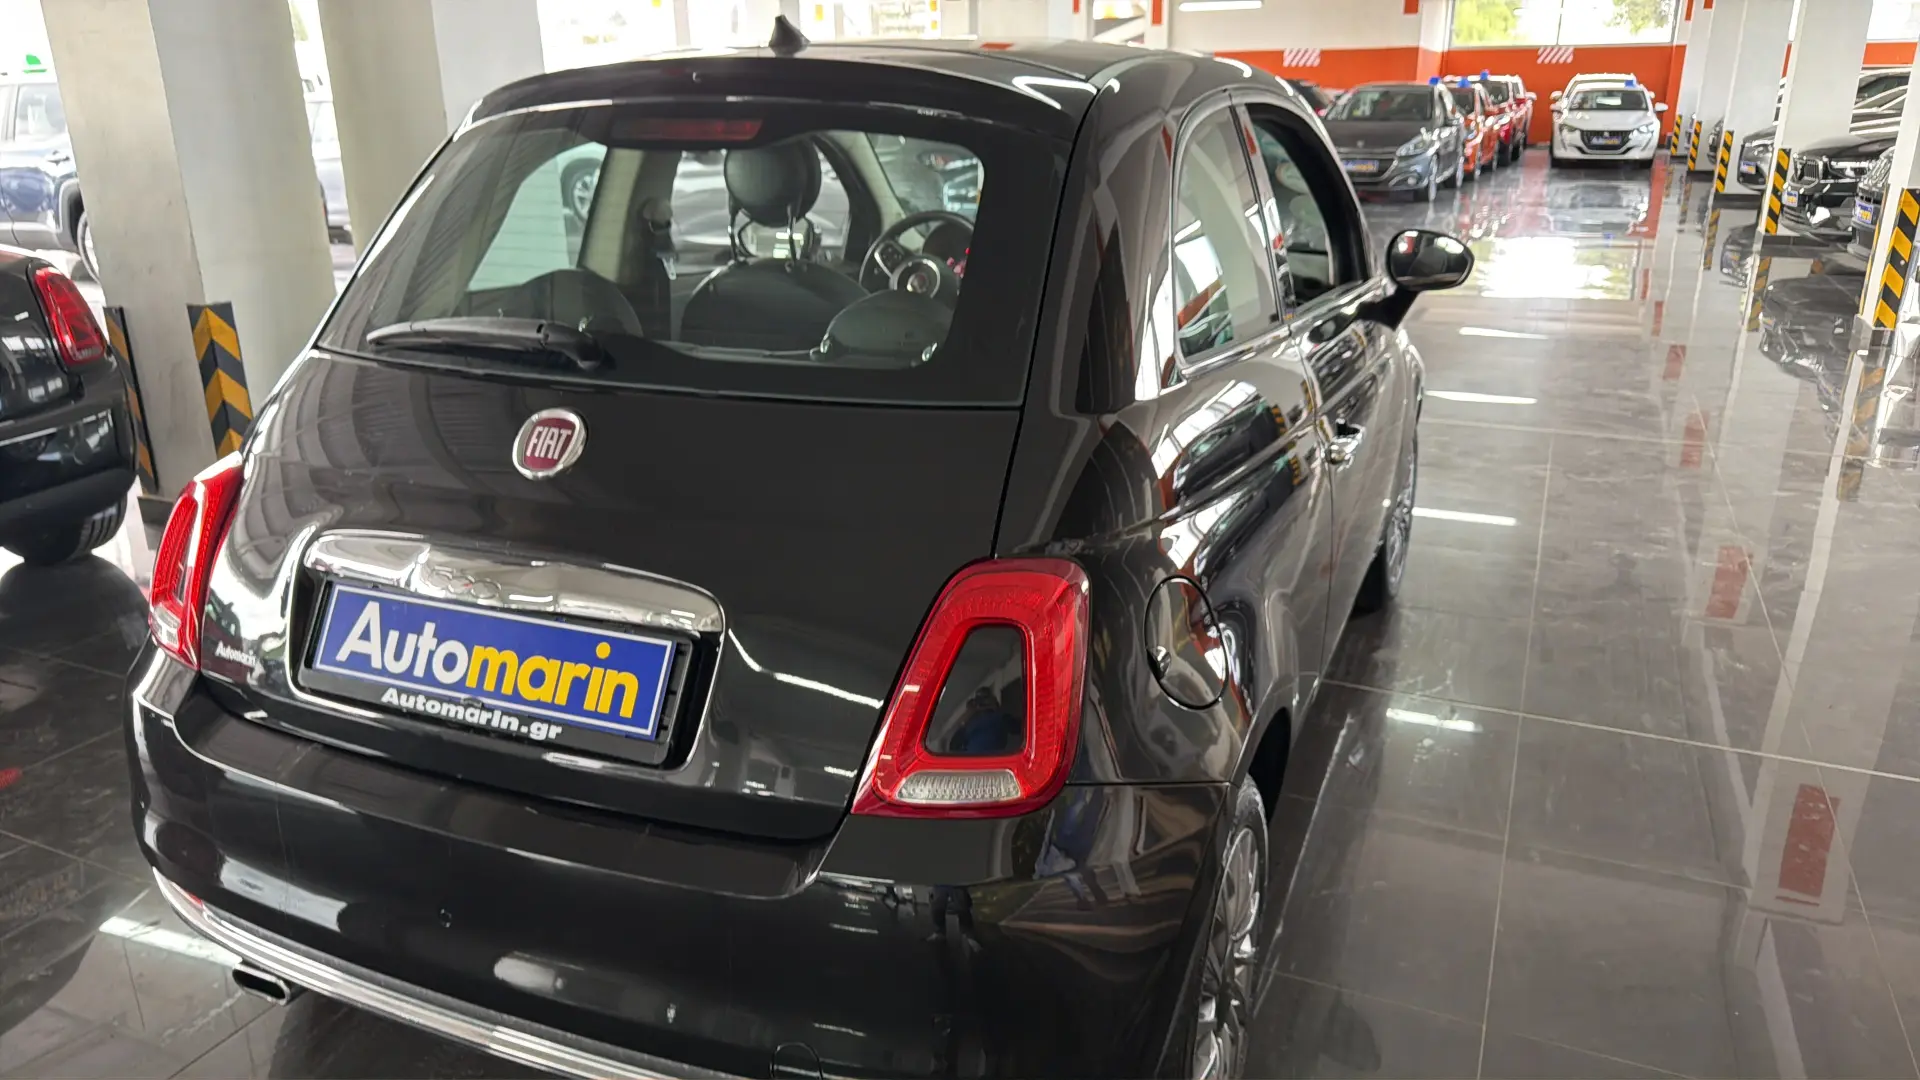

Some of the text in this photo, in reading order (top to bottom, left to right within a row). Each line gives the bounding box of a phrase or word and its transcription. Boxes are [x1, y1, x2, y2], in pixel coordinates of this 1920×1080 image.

[526, 426, 572, 460] FIAT
[336, 600, 639, 719] Automarin
[381, 687, 562, 741] Automarin.gr
